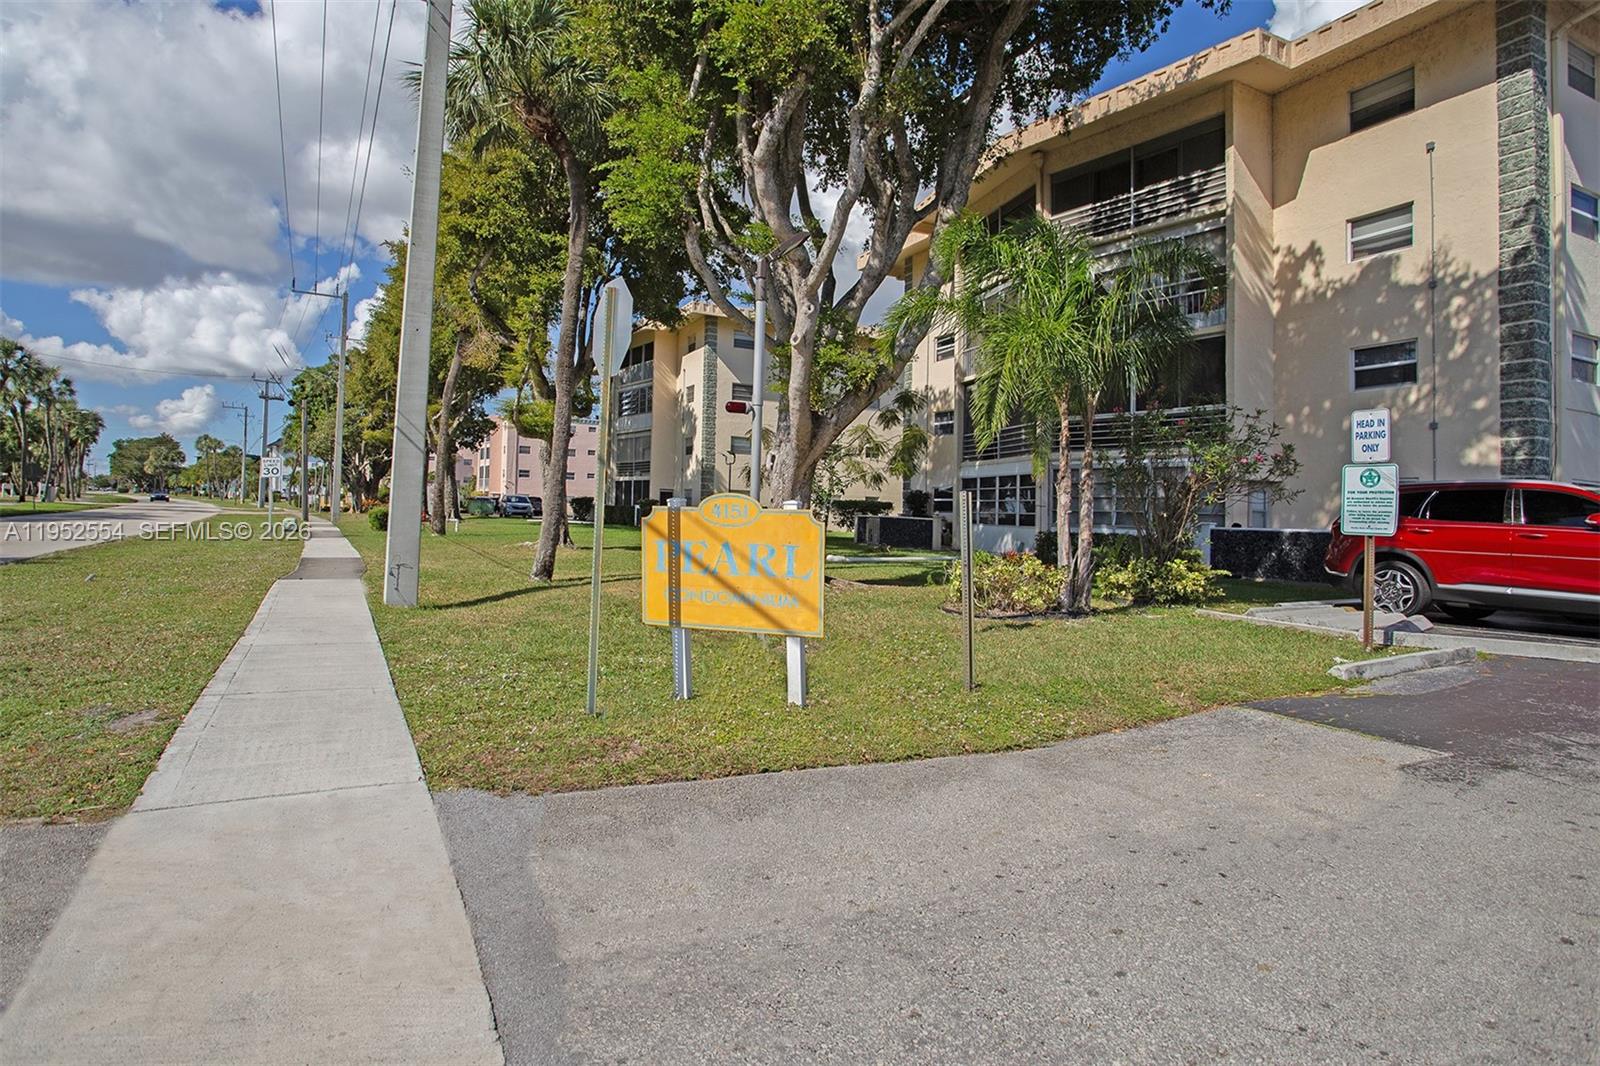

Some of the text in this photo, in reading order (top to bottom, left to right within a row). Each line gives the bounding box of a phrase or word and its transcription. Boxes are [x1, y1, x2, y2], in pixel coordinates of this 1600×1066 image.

[1356, 418, 1385, 428] HEAD IN
[1355, 430, 1386, 440] PARKING
[1361, 443, 1380, 452] ONLY
[263, 467, 280, 475] 30
[711, 503, 749, 520] 4151
[655, 538, 813, 580] PEARL
